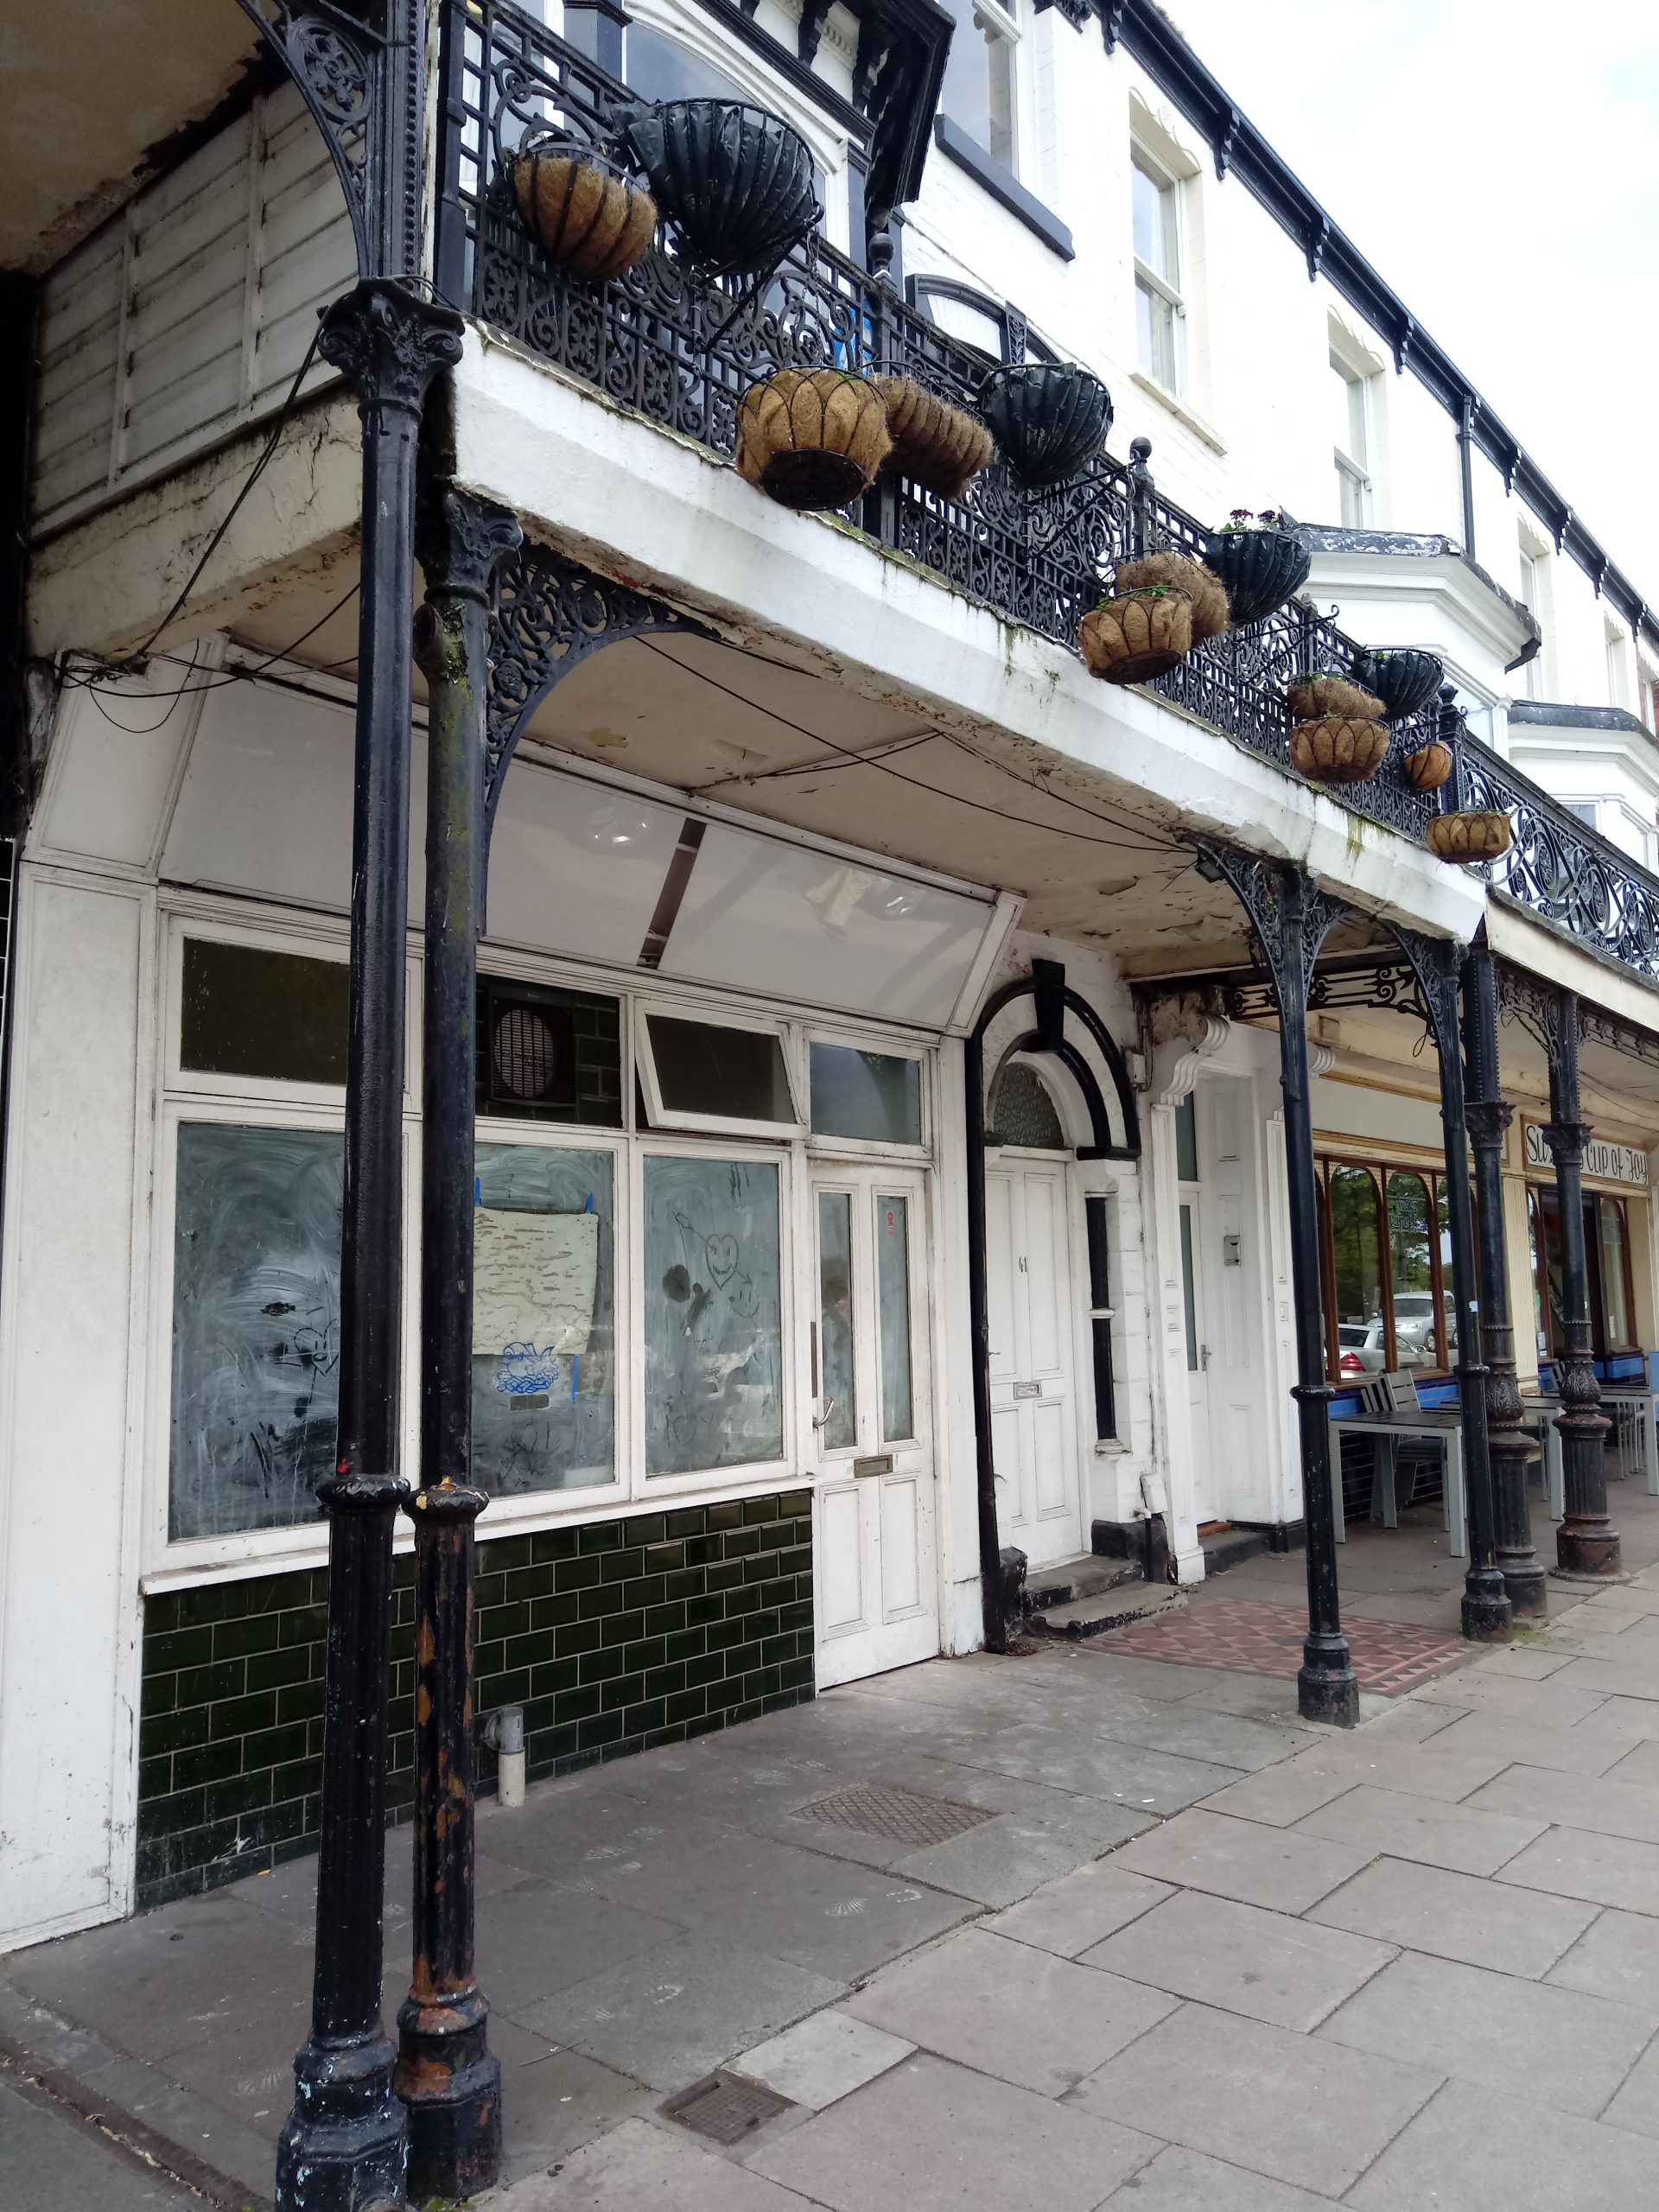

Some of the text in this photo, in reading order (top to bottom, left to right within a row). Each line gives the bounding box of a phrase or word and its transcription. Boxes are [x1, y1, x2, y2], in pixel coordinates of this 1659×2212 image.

[1586, 1141, 1608, 1176] Cup
[1611, 1147, 1624, 1179] of
[1625, 1148, 1648, 1185] Joy
[1018, 1255, 1027, 1273] 41
